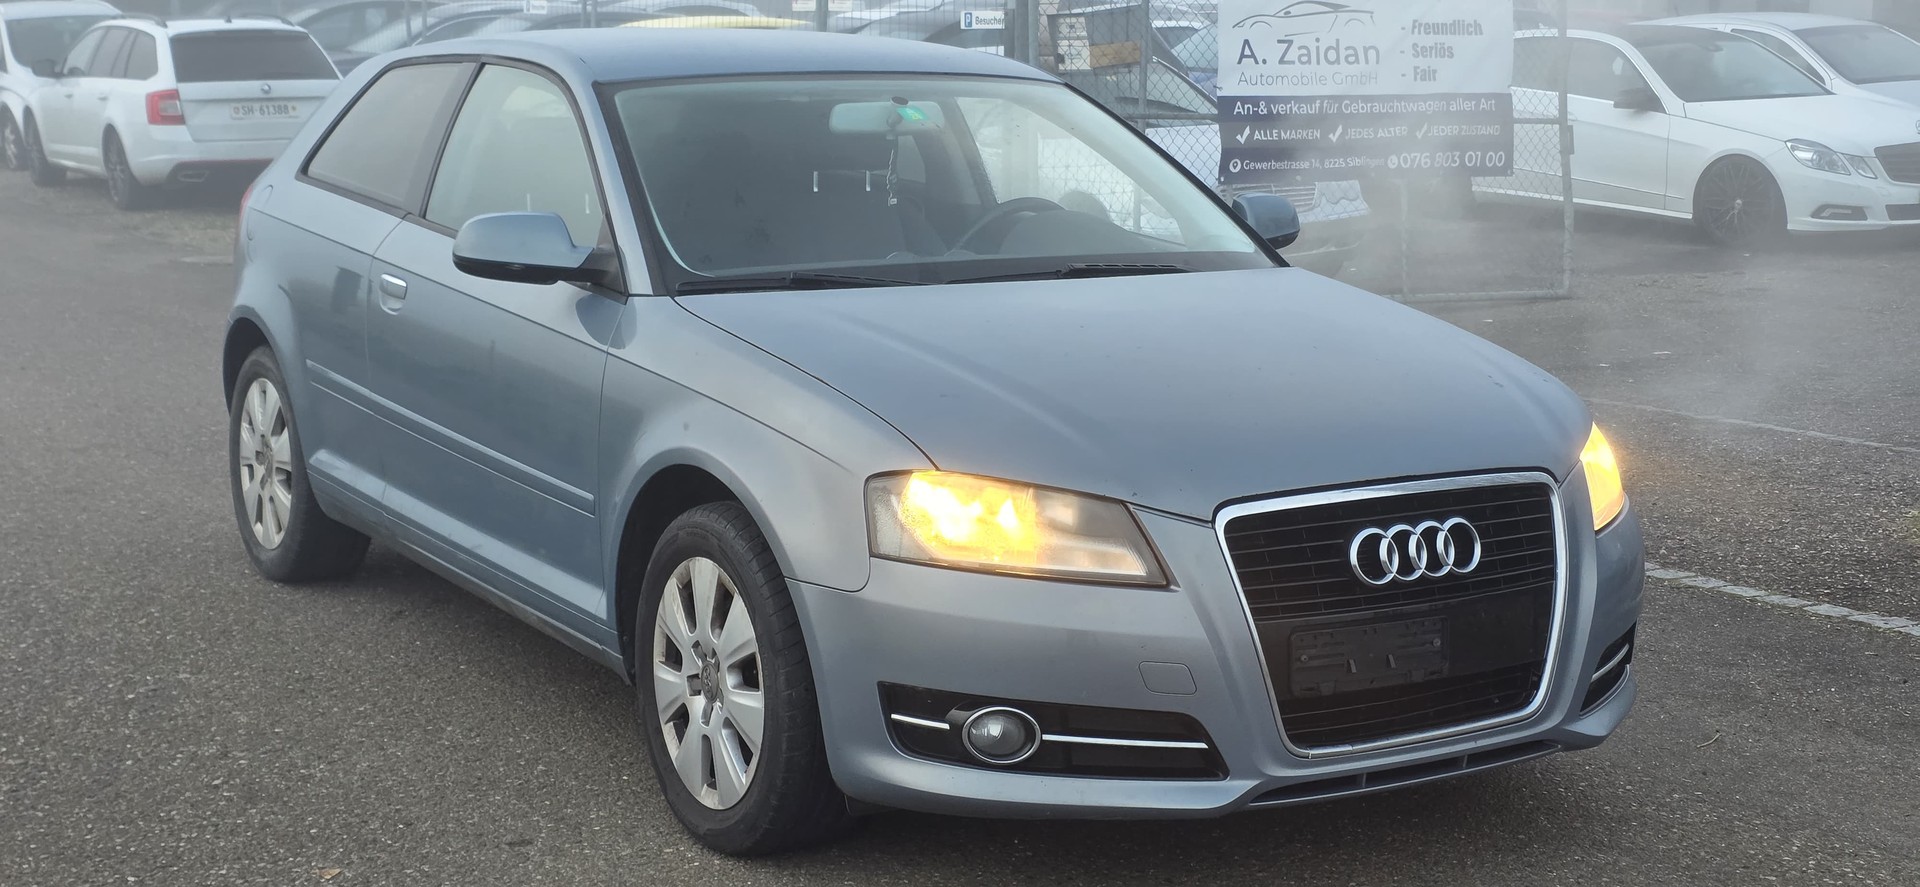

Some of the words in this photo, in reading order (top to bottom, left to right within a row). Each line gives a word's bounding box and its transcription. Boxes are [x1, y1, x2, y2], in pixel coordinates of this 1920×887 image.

[1411, 19, 1483, 36] Freundlich
[1236, 38, 1267, 65] A.
[1276, 37, 1380, 66] Zaidan
[1411, 42, 1454, 59] Seriös
[1237, 71, 1328, 86] Automobile
[1331, 71, 1378, 86] GmbH
[1413, 65, 1438, 82] Fair
[1270, 100, 1320, 115] verkauf
[1322, 100, 1339, 115] für
[1341, 98, 1447, 115] Gebrauchtwagen
[1449, 98, 1476, 112] aller
[1479, 97, 1496, 112] Art
[1253, 130, 1279, 141] ALLE
[1281, 128, 1321, 141] MARKEN
[1345, 127, 1375, 139] JEDES
[1376, 126, 1408, 138] ALTER
[1428, 125, 1459, 137] JEDER
[1461, 124, 1501, 136] ZUSTAND
[1243, 159, 1310, 170] Gewerbestrasse
[1324, 158, 1345, 168] 8225
[1400, 152, 1431, 169] 076
[1433, 151, 1461, 168] 803
[1464, 151, 1482, 168] 01
[1485, 151, 1506, 168] 00
